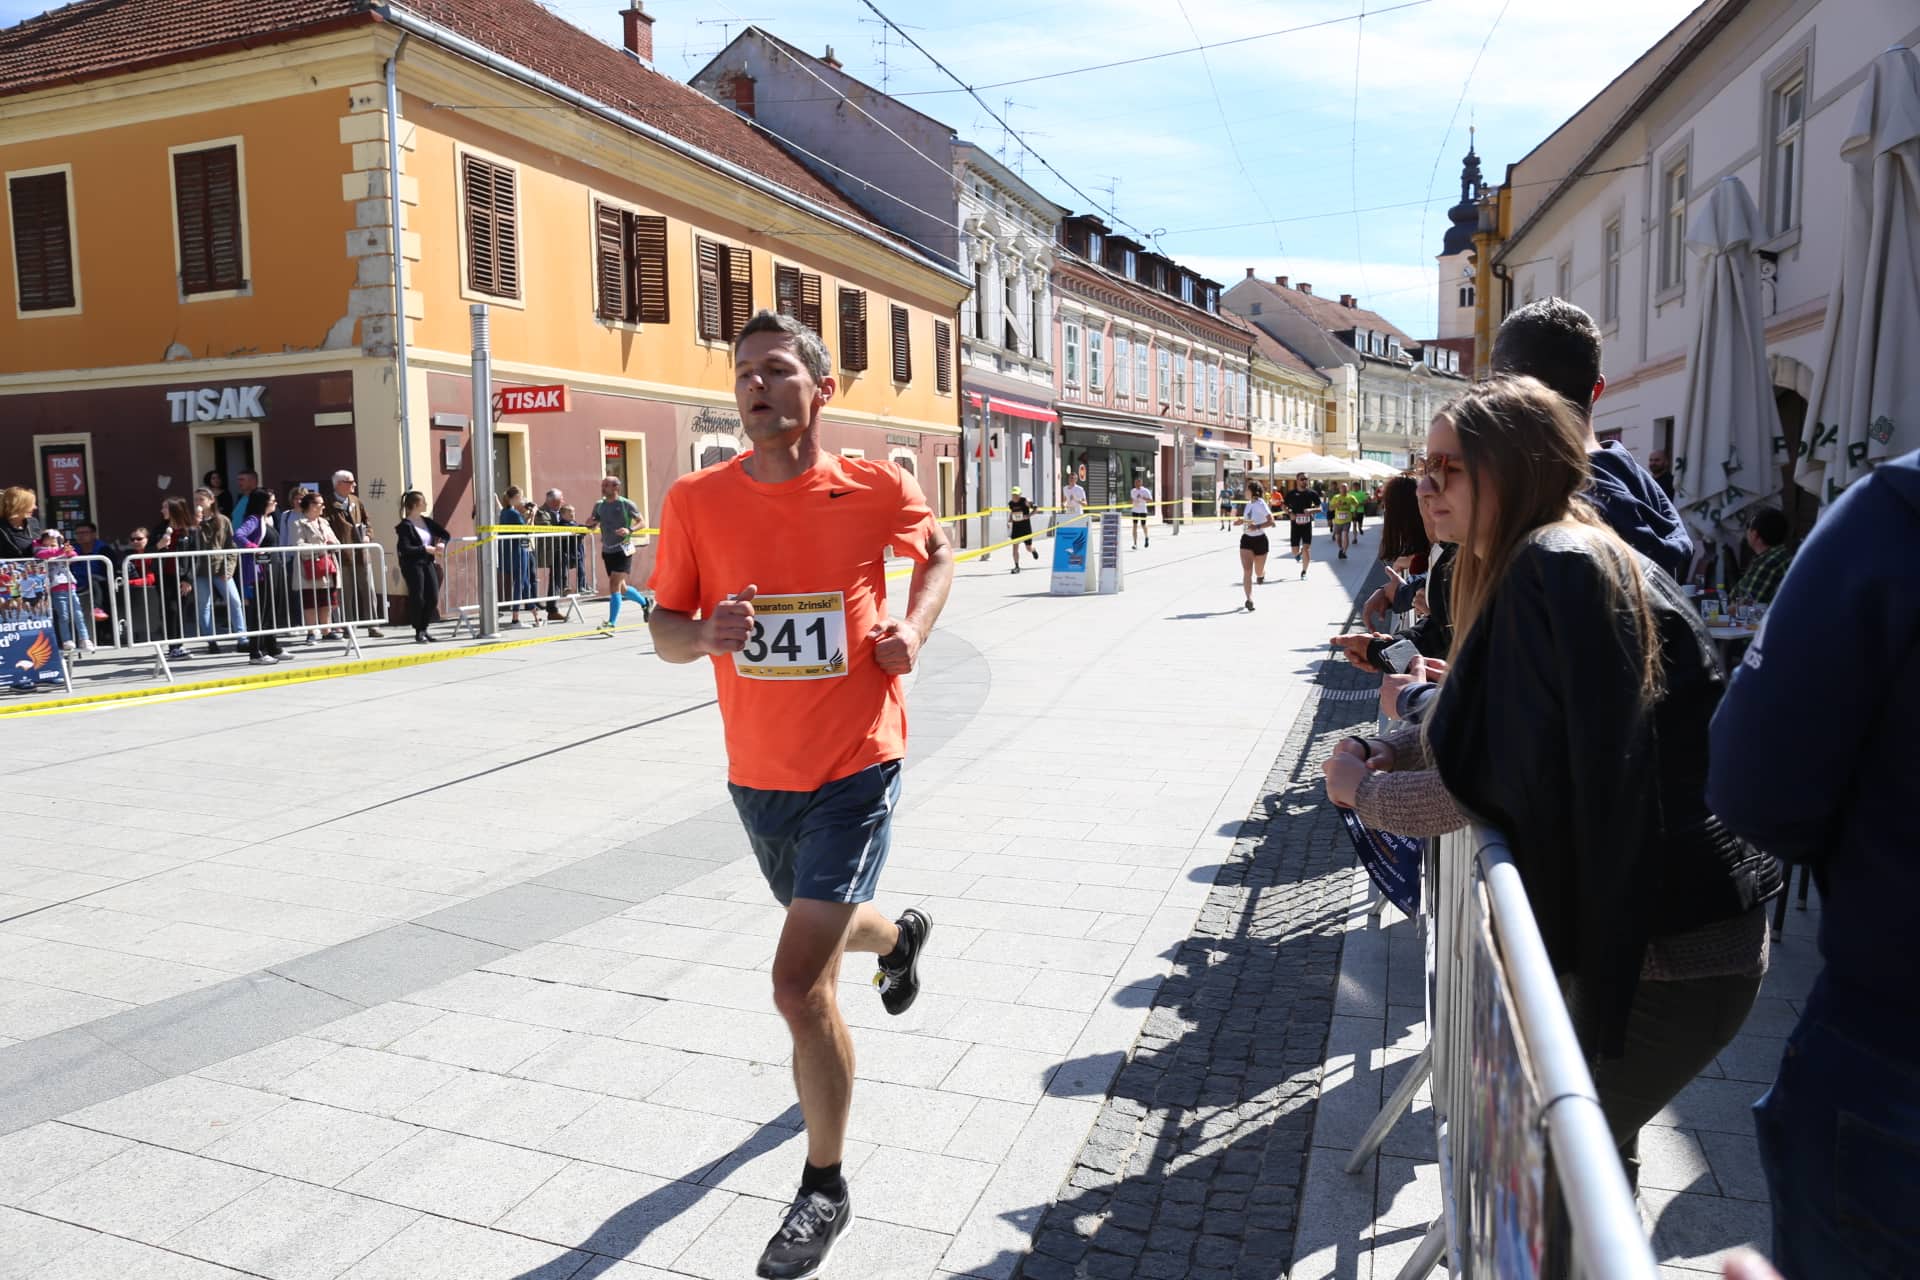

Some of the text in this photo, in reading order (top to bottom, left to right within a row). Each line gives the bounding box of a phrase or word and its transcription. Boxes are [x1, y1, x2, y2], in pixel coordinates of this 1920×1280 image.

[166, 385, 266, 423] TISAK
[505, 390, 560, 409] TISAK
[51, 457, 80, 469] TISAK
[0, 619, 52, 633] araton
[743, 617, 828, 663] 341
